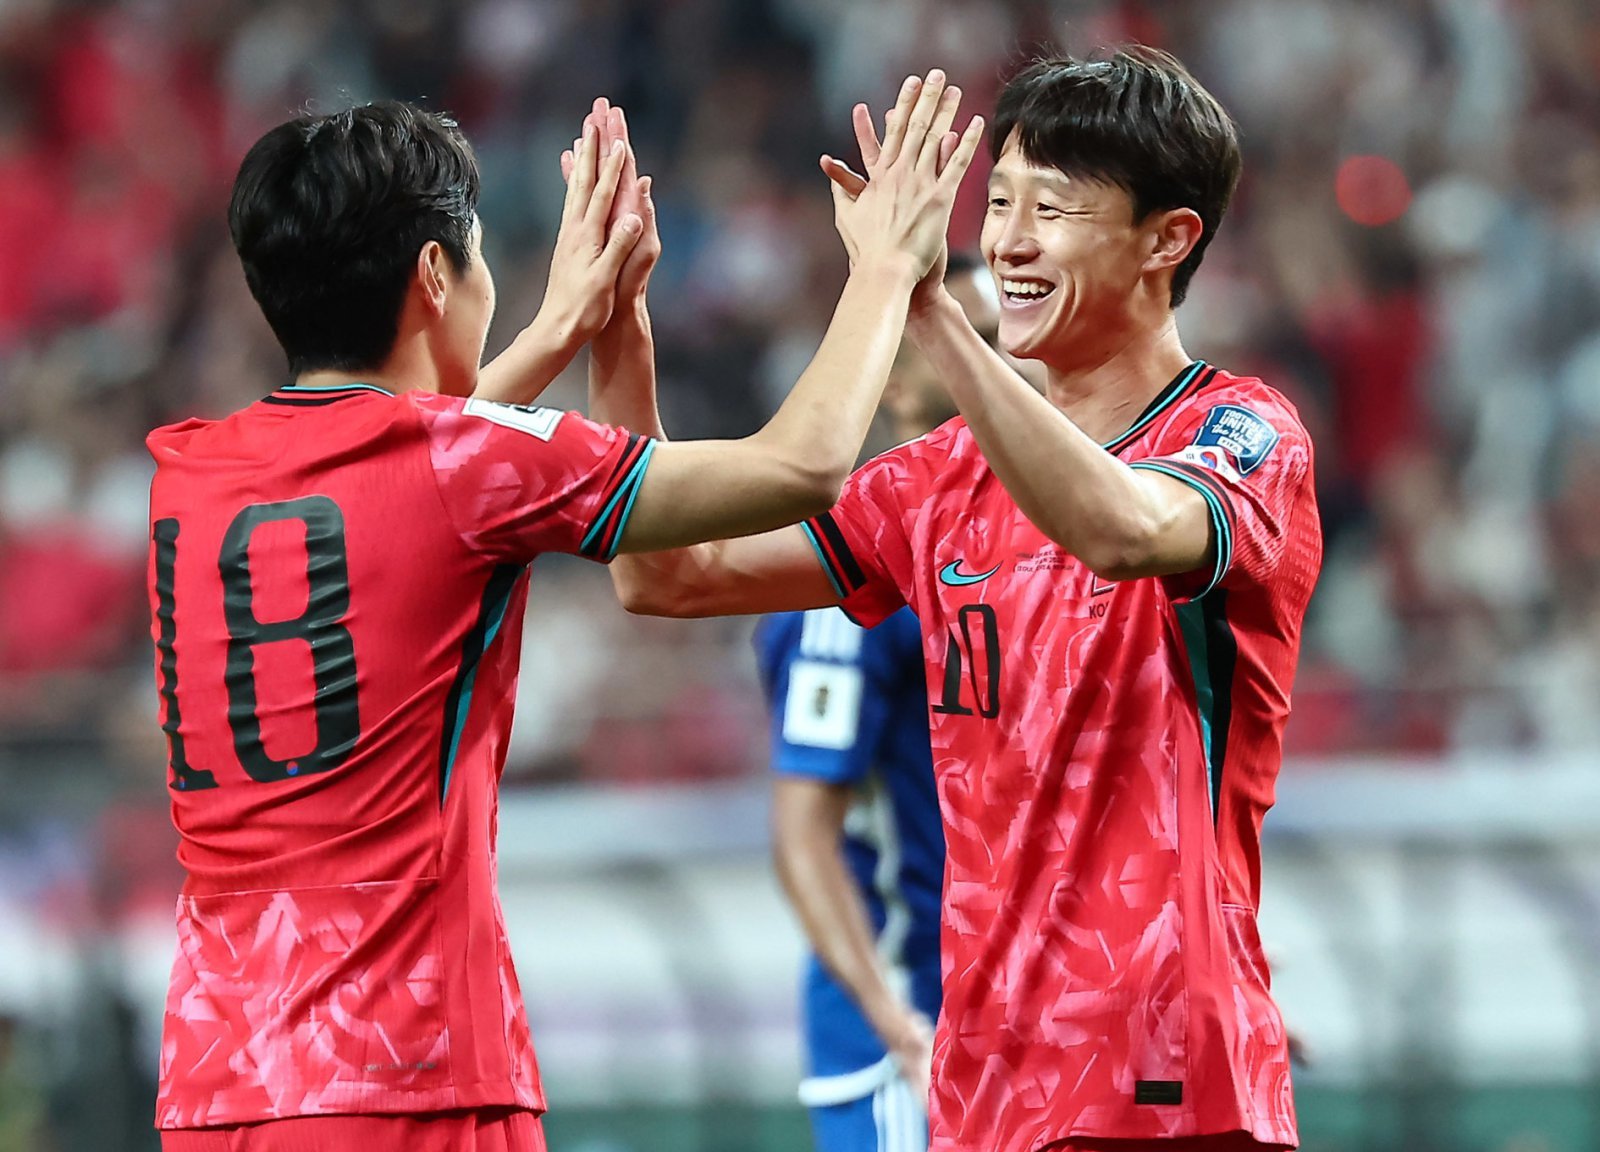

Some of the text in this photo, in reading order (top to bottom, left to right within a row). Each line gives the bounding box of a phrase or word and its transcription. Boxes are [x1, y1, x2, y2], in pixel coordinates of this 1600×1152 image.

[153, 494, 361, 792] 18
[932, 603, 999, 719] 10
[1088, 600, 1109, 619] KO
